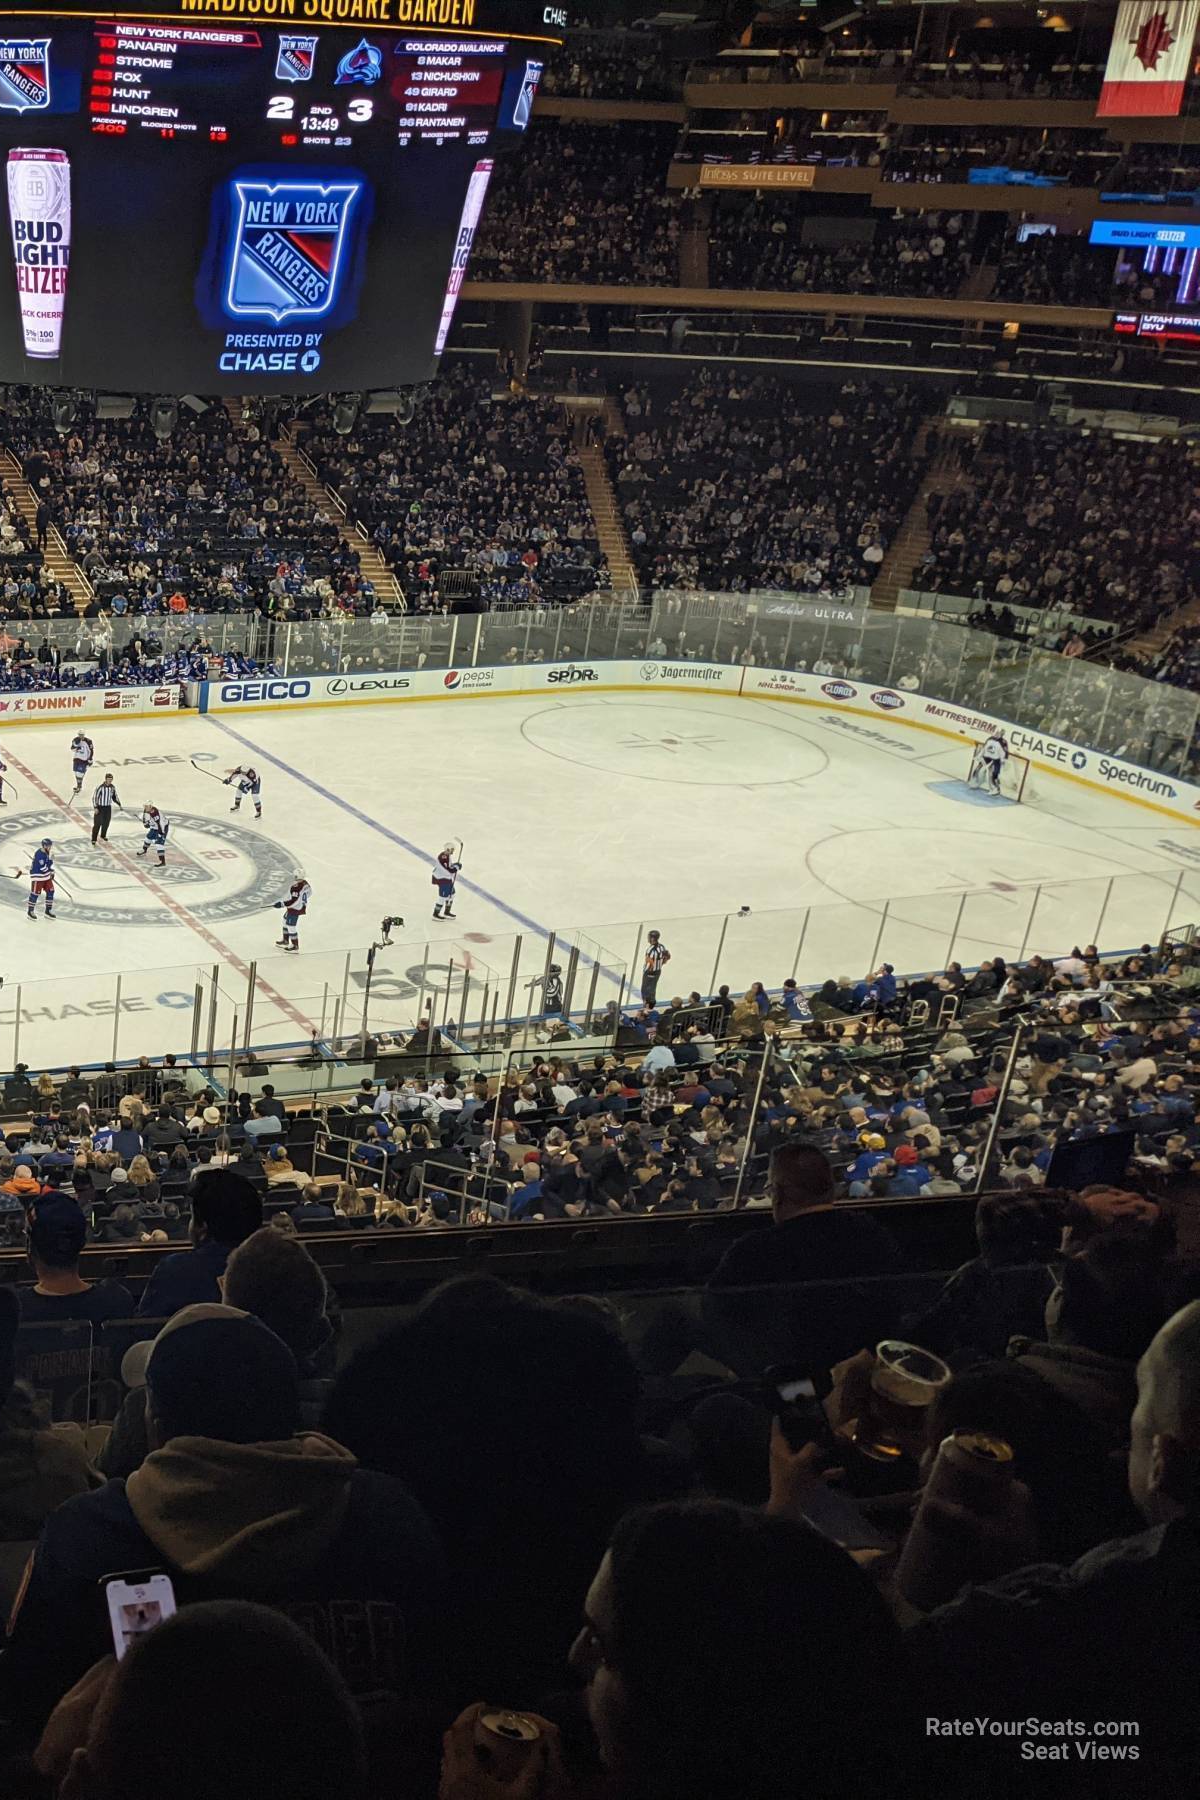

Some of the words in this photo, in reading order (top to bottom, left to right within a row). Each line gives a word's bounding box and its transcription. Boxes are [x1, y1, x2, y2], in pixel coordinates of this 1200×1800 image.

[303, 0, 390, 20] SQUARE
[398, 0, 475, 25] GARDEN
[116, 26, 146, 36] NEW
[148, 28, 182, 39] YORK
[183, 30, 243, 43] RANGERS
[117, 39, 177, 53] PANARIN
[281, 41, 295, 49] NEW
[297, 41, 313, 49] YORK
[405, 43, 457, 52] COLORADO
[458, 44, 504, 53] AVALANCHE
[17, 47, 44, 59] YORK
[116, 55, 172, 69] STROME
[285, 51, 309, 77] RANGERS
[418, 57, 426, 65] 8
[426, 57, 462, 66] MAKAR
[3, 64, 45, 103] RANGERS
[114, 72, 142, 82] FOX
[423, 72, 480, 82] NICHUSHKIN
[112, 88, 151, 100] HUNT
[404, 87, 420, 96] 49
[421, 88, 458, 97] GIRARD
[111, 103, 178, 118] LINDGREN
[266, 96, 295, 119] 2
[310, 107, 332, 115] 2ND
[347, 99, 374, 122] 3
[418, 103, 448, 112] KADRI
[141, 121, 172, 129] BLOCKED
[173, 122, 197, 130] SHOTS
[300, 117, 339, 131] 13:49
[415, 118, 465, 127] RANTANEN
[303, 137, 331, 145] SHOTS
[334, 137, 352, 145] 23
[743, 171, 774, 180] SUITE
[776, 171, 809, 182] LEVEL
[247, 201, 290, 223] NEW
[296, 201, 339, 223] YORK
[14, 220, 63, 243] BUD
[16, 244, 70, 266] IGHT
[255, 231, 326, 302] RANGERS
[17, 267, 68, 294] ELTZER
[1144, 315, 1173, 324] UTAH
[1142, 323, 1164, 331] BYU
[225, 334, 302, 348] PRESENTED
[304, 333, 323, 347] BY
[219, 353, 298, 371] CHASE
[815, 609, 854, 620] ULTRA
[462, 669, 494, 682] pepsi
[221, 680, 311, 703] GEICO
[350, 679, 410, 691] LEXUS
[825, 683, 853, 697] CLOROX
[27, 695, 87, 711] DUNKIN'
[874, 692, 901, 706] CLOROX
[1010, 731, 1069, 763] CHASE
[92, 754, 187, 768] HASE
[1098, 759, 1173, 799] Spectrum
[202, 849, 238, 861] 26
